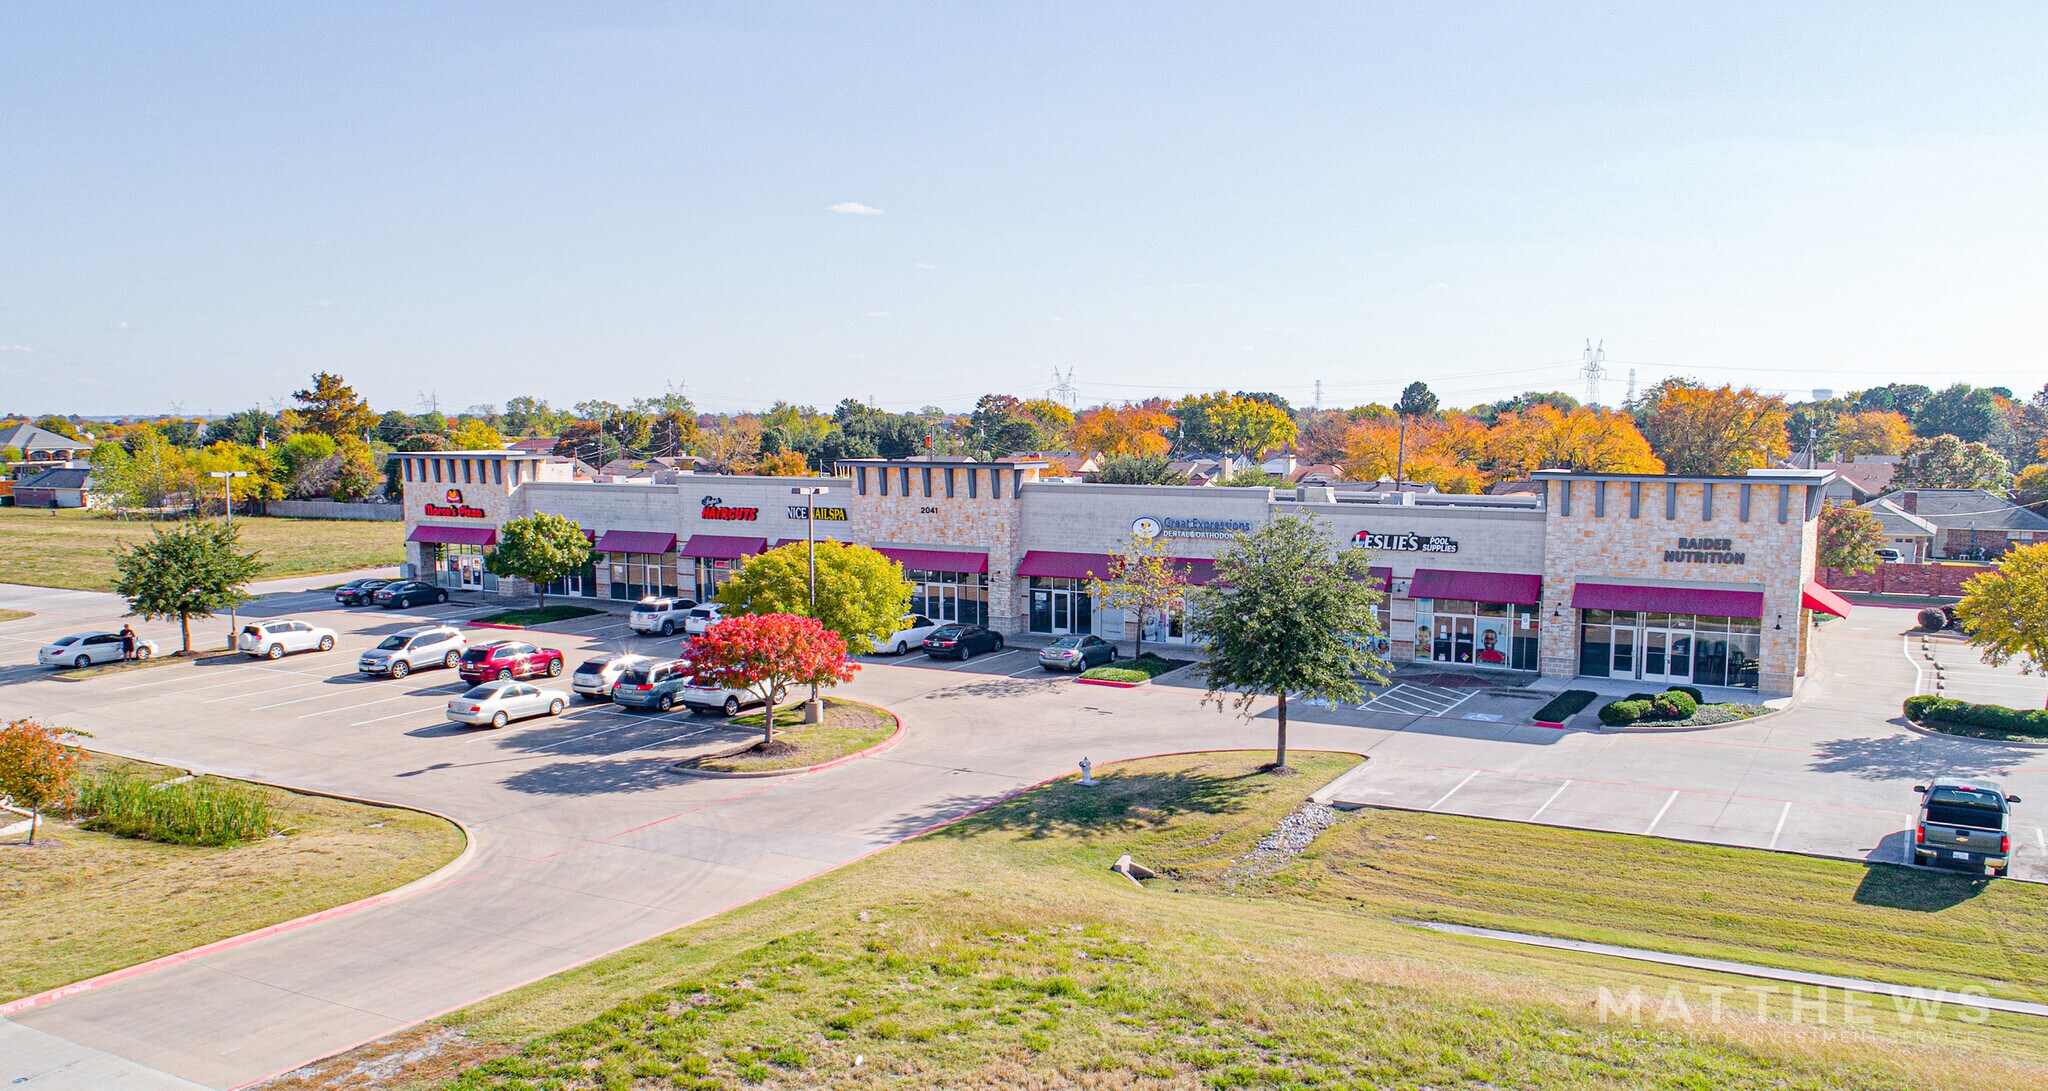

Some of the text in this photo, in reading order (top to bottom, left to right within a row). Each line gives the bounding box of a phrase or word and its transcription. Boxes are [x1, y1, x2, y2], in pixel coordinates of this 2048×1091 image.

[701, 507, 758, 521] HAIRCUTS
[787, 507, 807, 519] NICE
[920, 506, 938, 514] 2041
[1163, 517, 1250, 531] Great Expressions
[1163, 530, 1189, 538] DENTAL
[1429, 536, 1449, 545] POOL
[1355, 532, 1419, 551] LESLIE'S
[1678, 537, 1732, 551] RAIDER
[1422, 544, 1457, 553] SUPPLIES
[1663, 550, 1746, 565] NUTRITION
